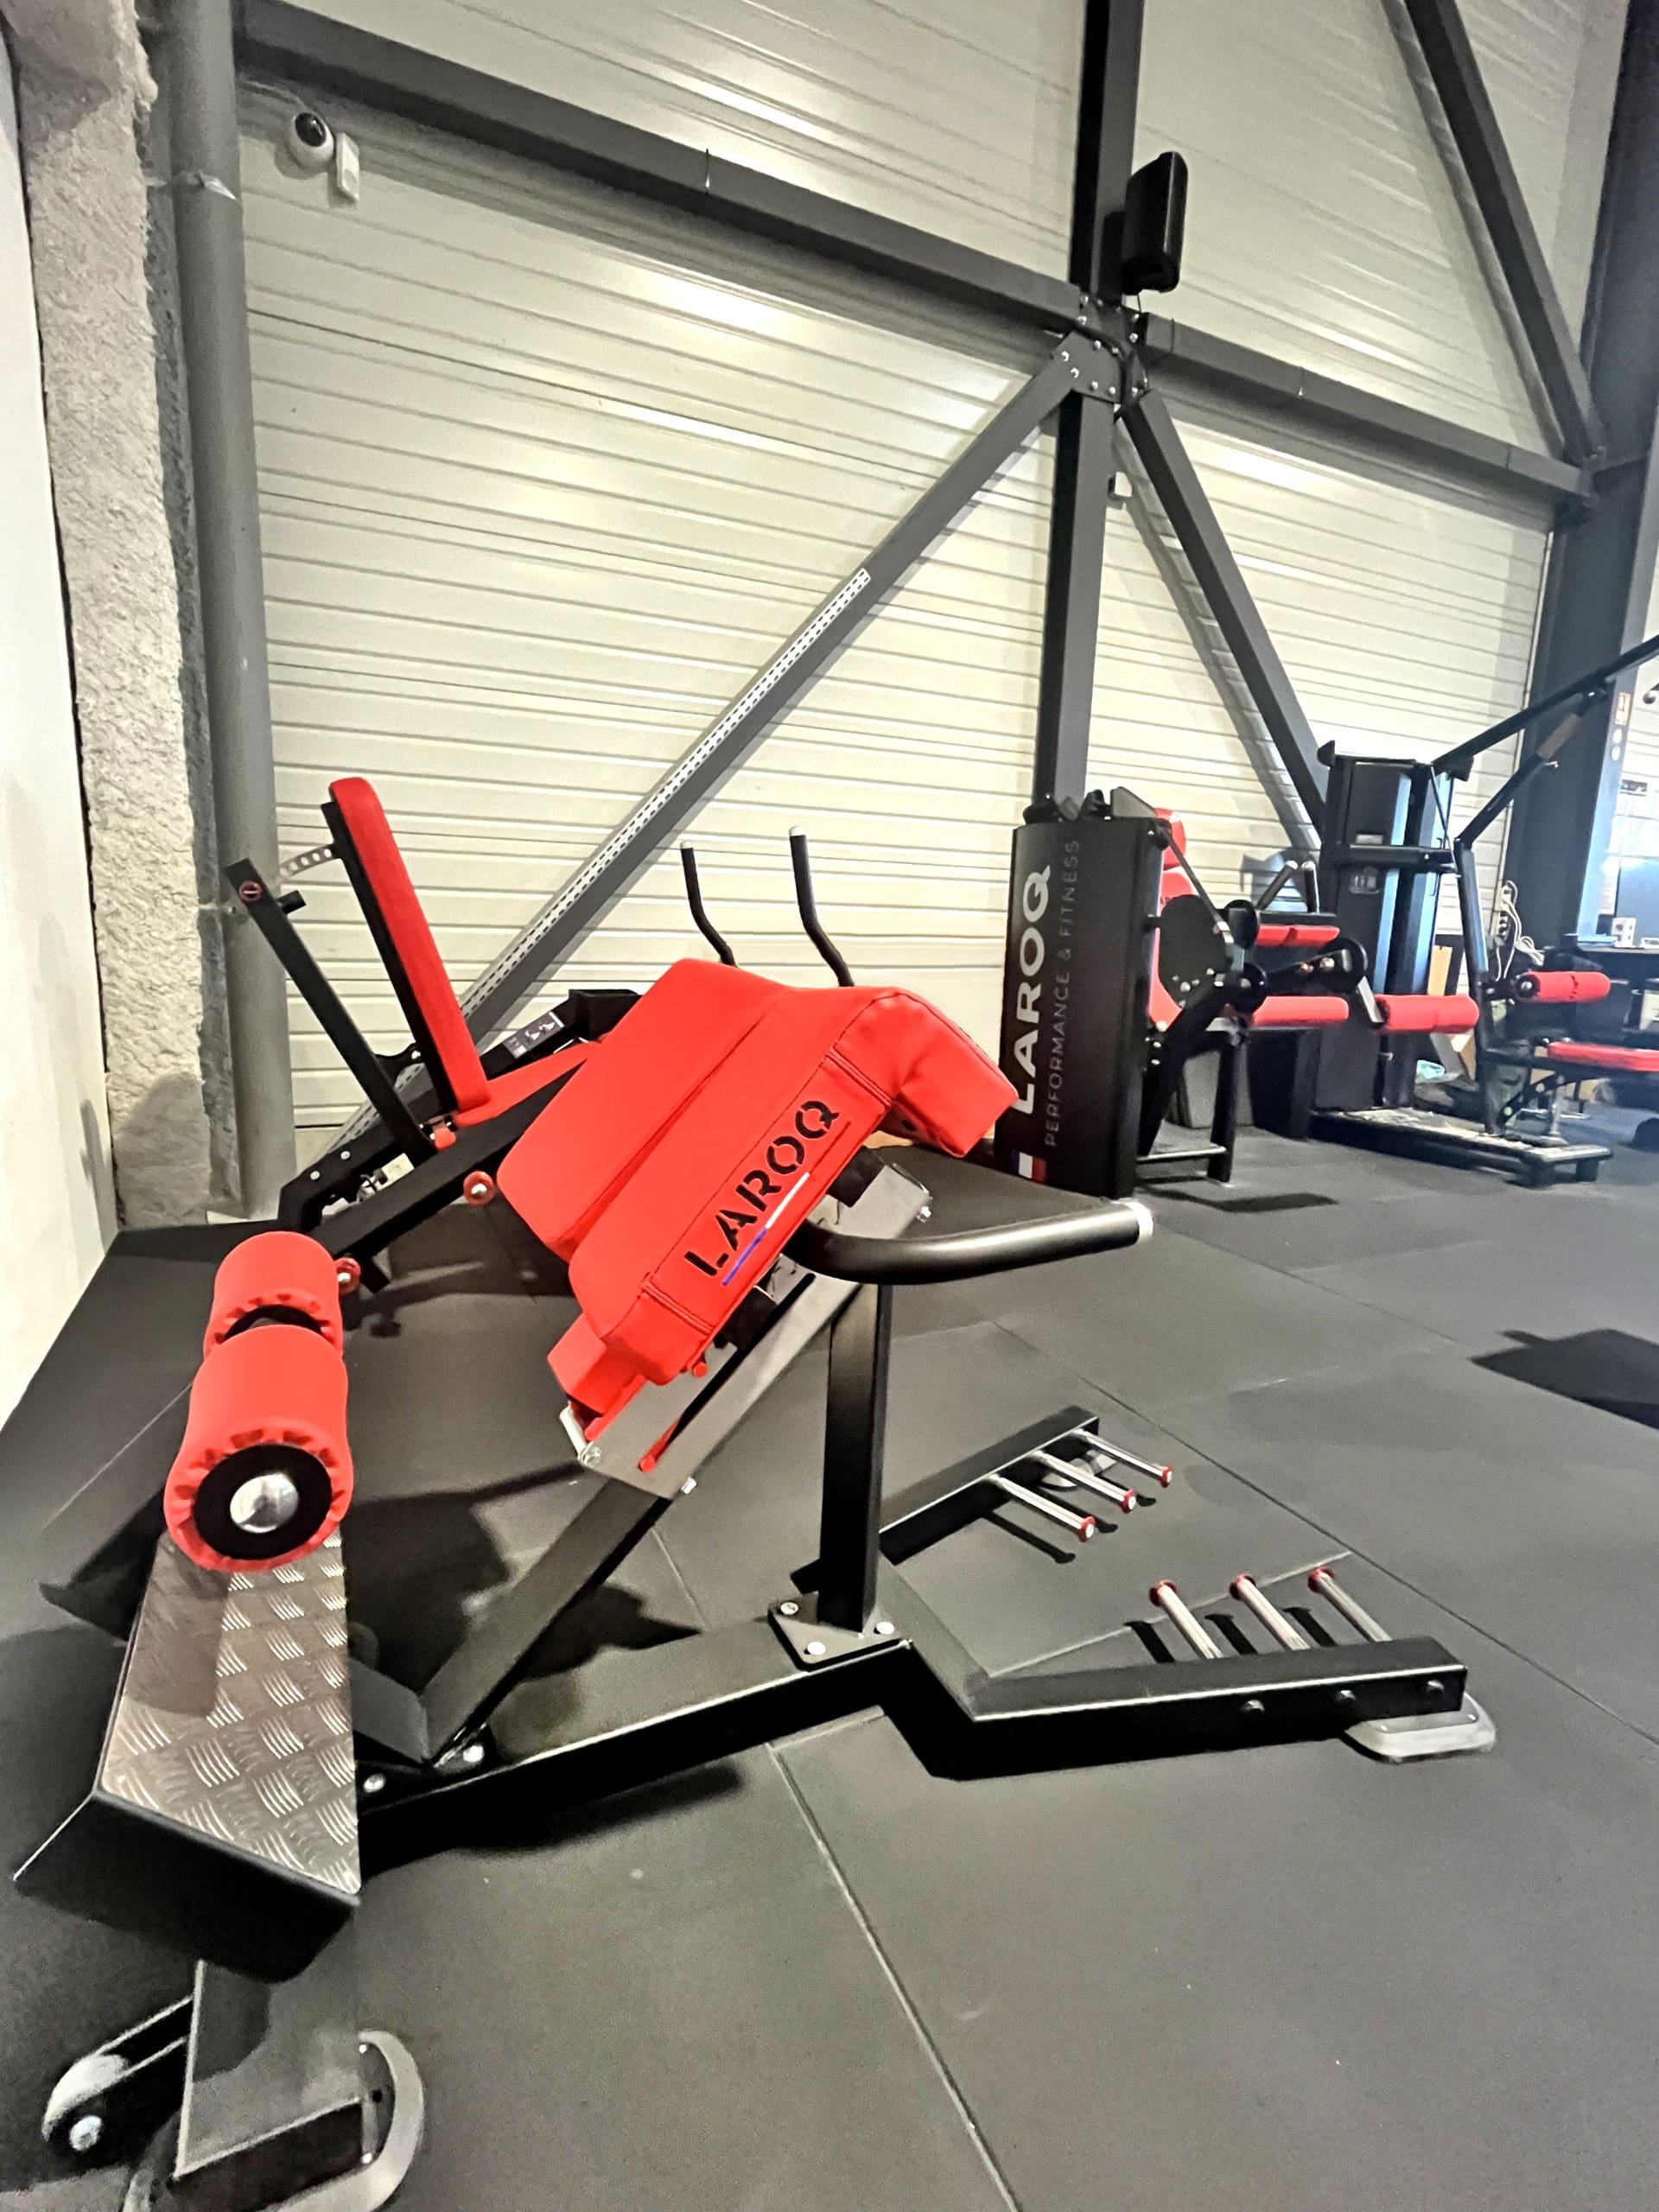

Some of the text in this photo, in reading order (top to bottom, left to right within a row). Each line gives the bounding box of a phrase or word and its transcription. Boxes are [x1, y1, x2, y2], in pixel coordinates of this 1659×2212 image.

[1013, 865, 1051, 1115] LAROQ
[1045, 839, 1079, 1147] PERFORMANCE & FITNESS
[684, 1101, 839, 1276] LAROQ
